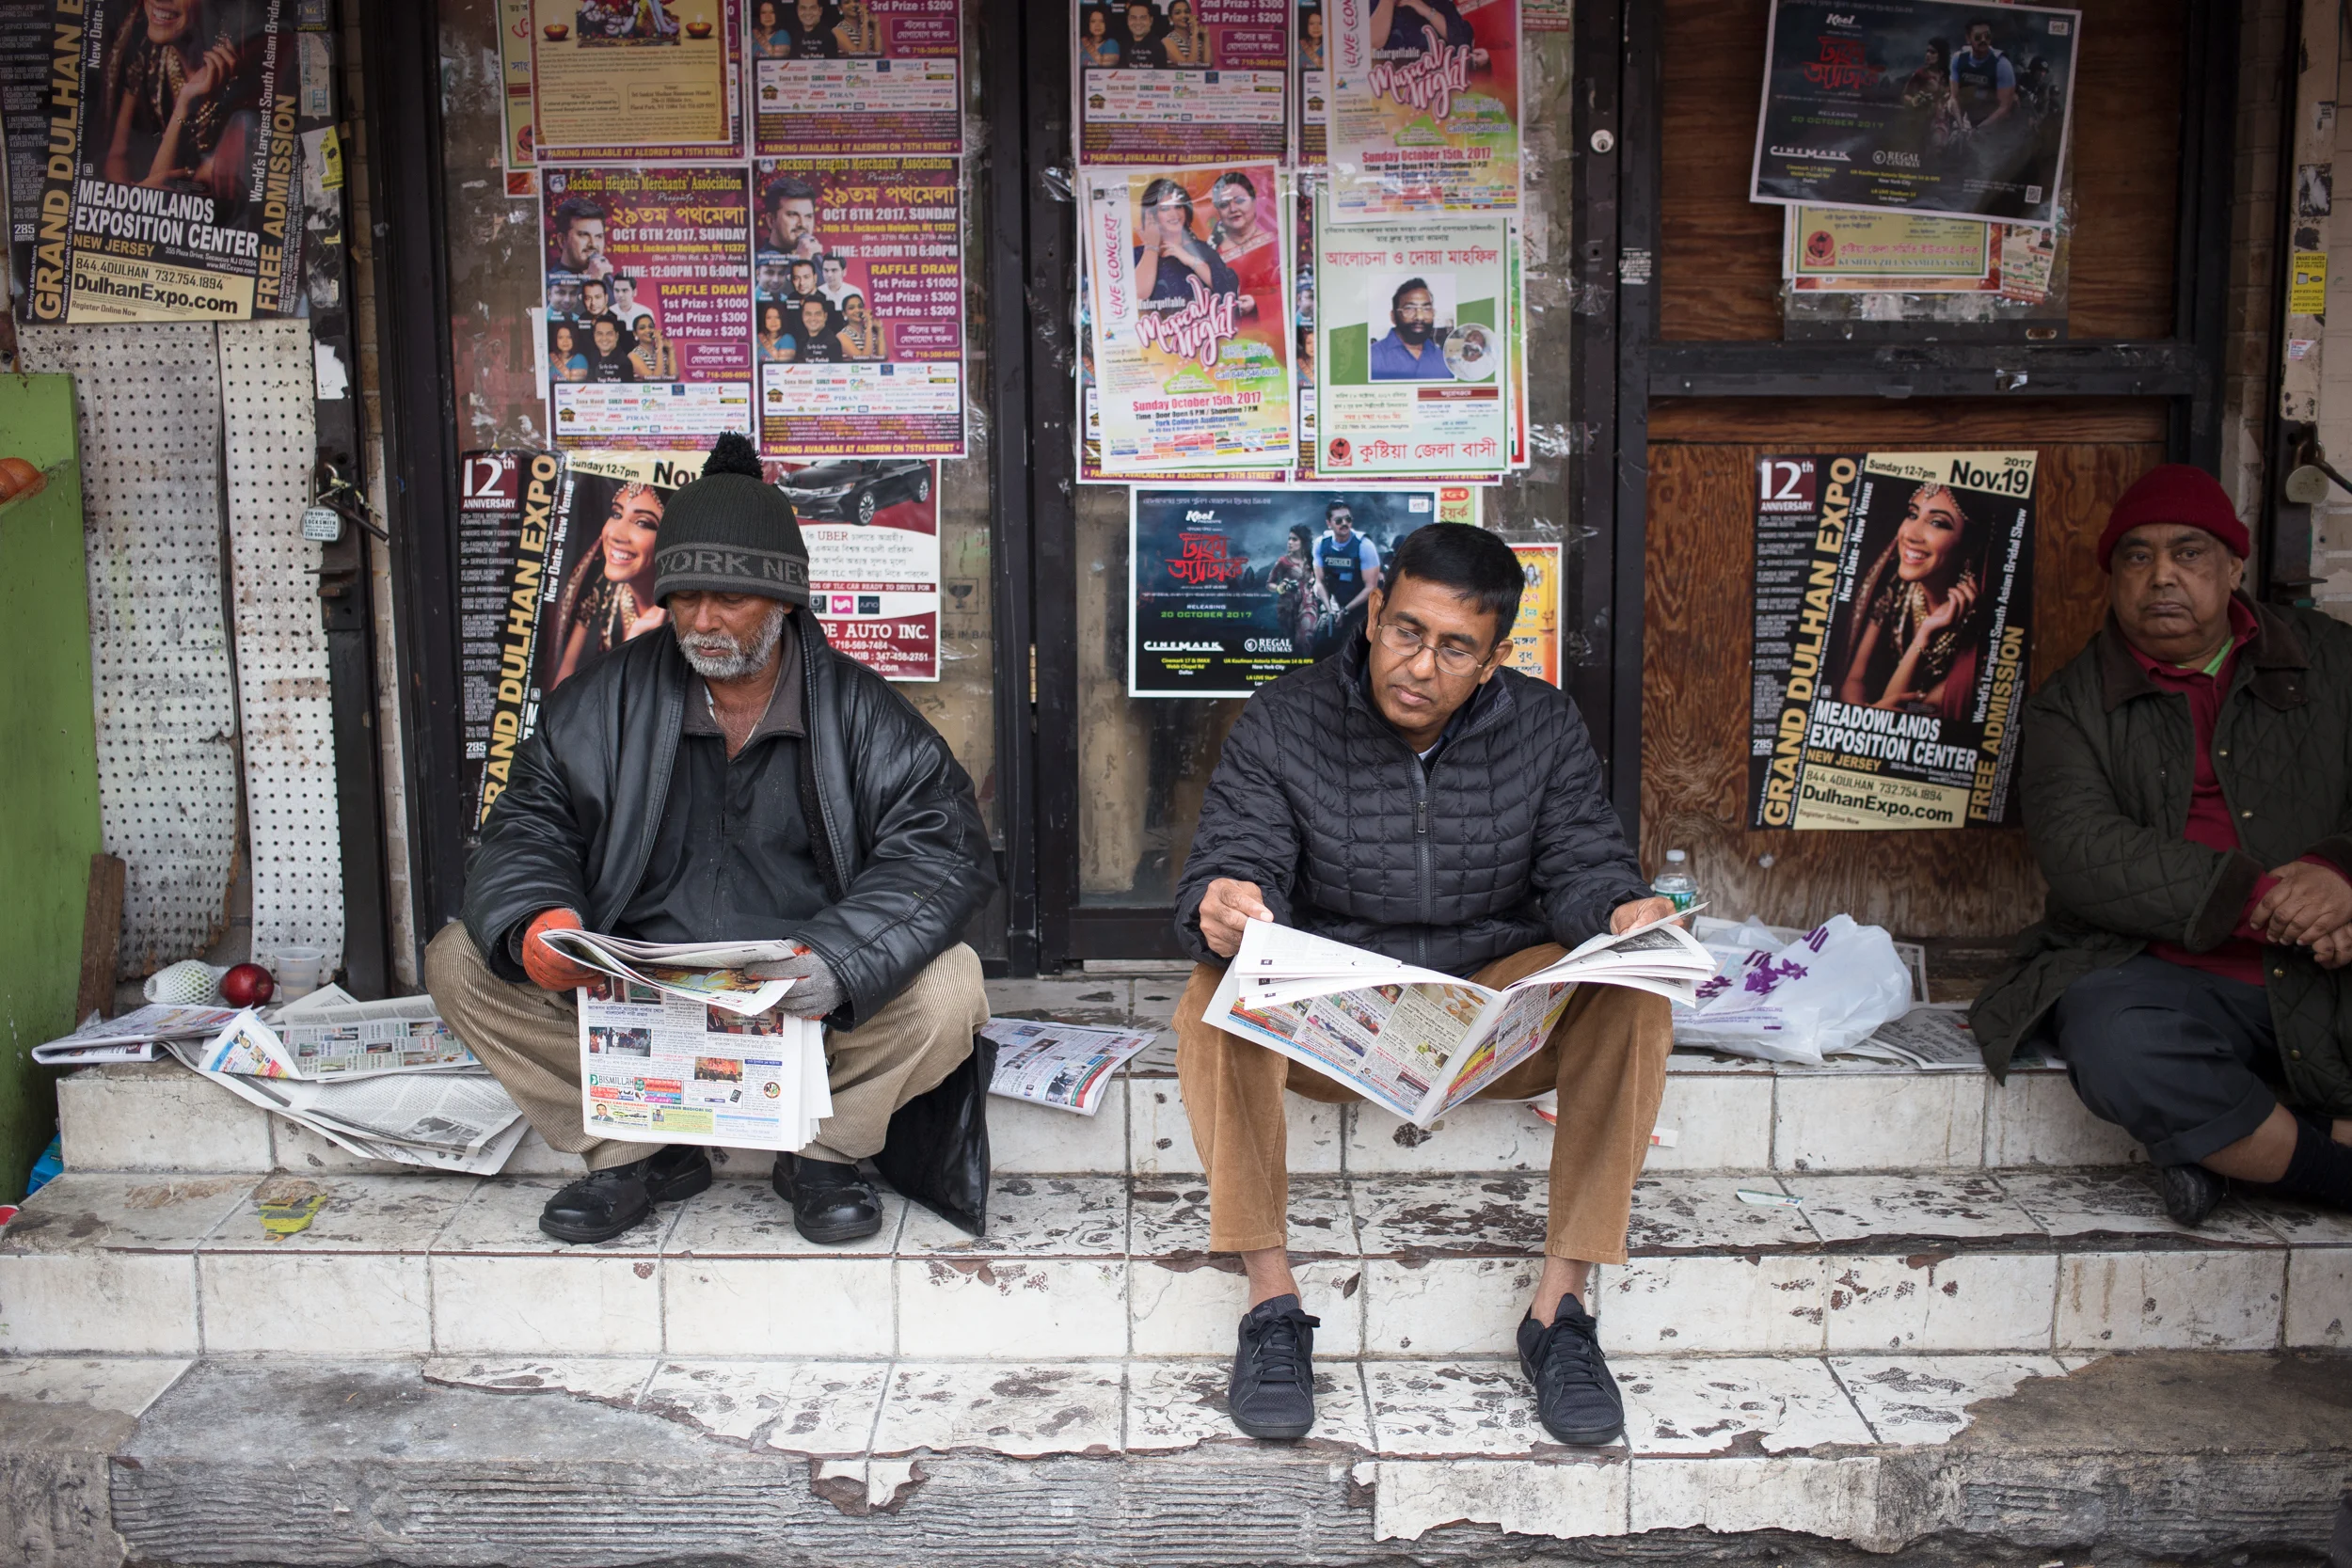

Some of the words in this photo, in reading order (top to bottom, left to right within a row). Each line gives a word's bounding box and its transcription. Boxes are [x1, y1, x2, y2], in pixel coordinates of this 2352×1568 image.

[89, 10, 103, 40] Date
[87, 43, 102, 69] New
[262, 36, 277, 69] Asian
[260, 71, 274, 107] South
[1405, 44, 1470, 119] Night
[47, 24, 83, 181] DULHAN
[255, 109, 271, 158] Largest
[263, 94, 296, 239] ADMISSION
[777, 158, 813, 170] Jackson
[816, 158, 849, 173] Heights
[901, 157, 952, 169] Association
[1770, 146, 1851, 162] CINEMARK
[1886, 151, 1920, 163] REGAL
[249, 154, 266, 202] World's
[567, 176, 602, 191] Jackson
[605, 176, 639, 194] Heights
[691, 175, 742, 191] Association
[78, 180, 215, 223] MEADOWLANDS
[884, 185, 956, 204] পথমেলা
[675, 205, 747, 226] পথমেলা
[822, 208, 846, 220] OCT
[850, 208, 873, 220] 8TH
[875, 208, 907, 221] 2017,
[909, 208, 957, 220] SUNDAY
[14, 224, 35, 234] 285
[75, 206, 183, 246] EXPOSITION
[188, 223, 259, 258] CENTER
[612, 228, 636, 241] OCT
[639, 228, 663, 241] 8TH
[665, 228, 697, 243] 2017,
[699, 228, 747, 241] SUNDAY
[35, 190, 70, 319] GRAND
[73, 234, 102, 250] NEW
[105, 241, 155, 257] JERSEY
[205, 253, 230, 262] Secaucus
[831, 245, 858, 258] TIME:
[860, 245, 903, 258] 12:00PM
[919, 245, 958, 257] 6:00PM
[1104, 214, 1121, 279] CONCERT
[1325, 251, 1387, 267] আলোচনা
[1393, 252, 1404, 263] ও
[1407, 250, 1443, 266] দোয়া
[1447, 245, 1498, 266] মাহফিল
[75, 258, 149, 278] 844.4DULHAN
[155, 269, 223, 291] 732.754.1894
[256, 245, 282, 310] FREE
[622, 265, 649, 277] TIME:
[650, 265, 692, 277] 12:00PM
[694, 265, 707, 277] TO
[709, 265, 748, 277] 6:00PM
[871, 264, 917, 275] RAFFLE
[921, 264, 958, 275] DRAW
[74, 273, 238, 313] DulhanExpo.com
[660, 285, 708, 295] RAFFLE
[711, 285, 748, 295] DRAW
[872, 278, 889, 288] 1st
[891, 278, 917, 288] Prize
[926, 277, 958, 288] $1000
[72, 300, 100, 313] Register
[101, 304, 121, 314] Online
[662, 298, 679, 309] 1st
[681, 298, 707, 309] Prize
[716, 298, 749, 309] $1000
[1136, 274, 1212, 353] Musical
[664, 312, 684, 323] 2nd
[686, 312, 712, 323] Prize
[721, 312, 747, 323] $300
[1173, 292, 1238, 366] Night
[665, 326, 683, 337] 3rd
[686, 326, 712, 337] Prize
[721, 326, 747, 337] $200
[1133, 400, 1168, 412] Sunday
[1171, 396, 1209, 408] October
[1237, 391, 1261, 404] 2017
[770, 445, 803, 454] PARKING
[803, 445, 844, 453] AVAILABLE
[846, 445, 855, 453] AT
[893, 444, 903, 452] ON
[905, 444, 924, 452] 75TH
[926, 443, 954, 452] STREET
[1415, 443, 1455, 458] জেলা
[1461, 436, 1498, 458] বাসী
[606, 463, 640, 478] 12-7pm
[1868, 459, 1903, 476] Sunday
[1905, 465, 1936, 480] 12-7pm
[2004, 456, 2032, 468] 2017
[463, 456, 516, 498] 12th
[1760, 461, 1814, 499] 12th
[1949, 459, 2029, 495] Nov.19
[463, 499, 516, 509] ANNIVERSARY
[519, 454, 557, 553] EXPO
[557, 480, 575, 515] Venue
[1760, 500, 1813, 512] ANNIVERSARY
[553, 516, 568, 542] New
[2010, 508, 2027, 538] Show
[818, 531, 849, 541] UBER
[548, 547, 564, 576] Date
[660, 550, 754, 576] YORK
[2003, 538, 2022, 573] Bridal
[544, 577, 559, 602] New
[896, 583, 915, 592] DRIVE
[917, 583, 930, 592] FOR
[498, 559, 541, 705] DULHAN
[845, 624, 893, 639] AUTO
[898, 625, 930, 640] INC.
[1989, 606, 2007, 639] South
[1143, 641, 1224, 651] CINEMARK
[1259, 639, 1291, 647] REGAL
[1763, 707, 1807, 826] GRAND
[1786, 560, 1838, 702] DULHAN
[1815, 457, 1857, 554] EXPO
[1972, 682, 1992, 723] World's
[1981, 626, 2026, 755] ADMISSION
[1813, 699, 1942, 742] MEADOWLANDS
[466, 741, 486, 752] 285
[1808, 722, 1911, 762] EXPOSITION
[1913, 740, 1979, 773] CENTER
[1805, 749, 1836, 764] NEW
[1836, 754, 1883, 772] JERSEY
[1968, 760, 1997, 821] FREE
[1802, 784, 1954, 823] DulhanExpo.com
[598, 1075, 634, 1086] BISMILLAH
